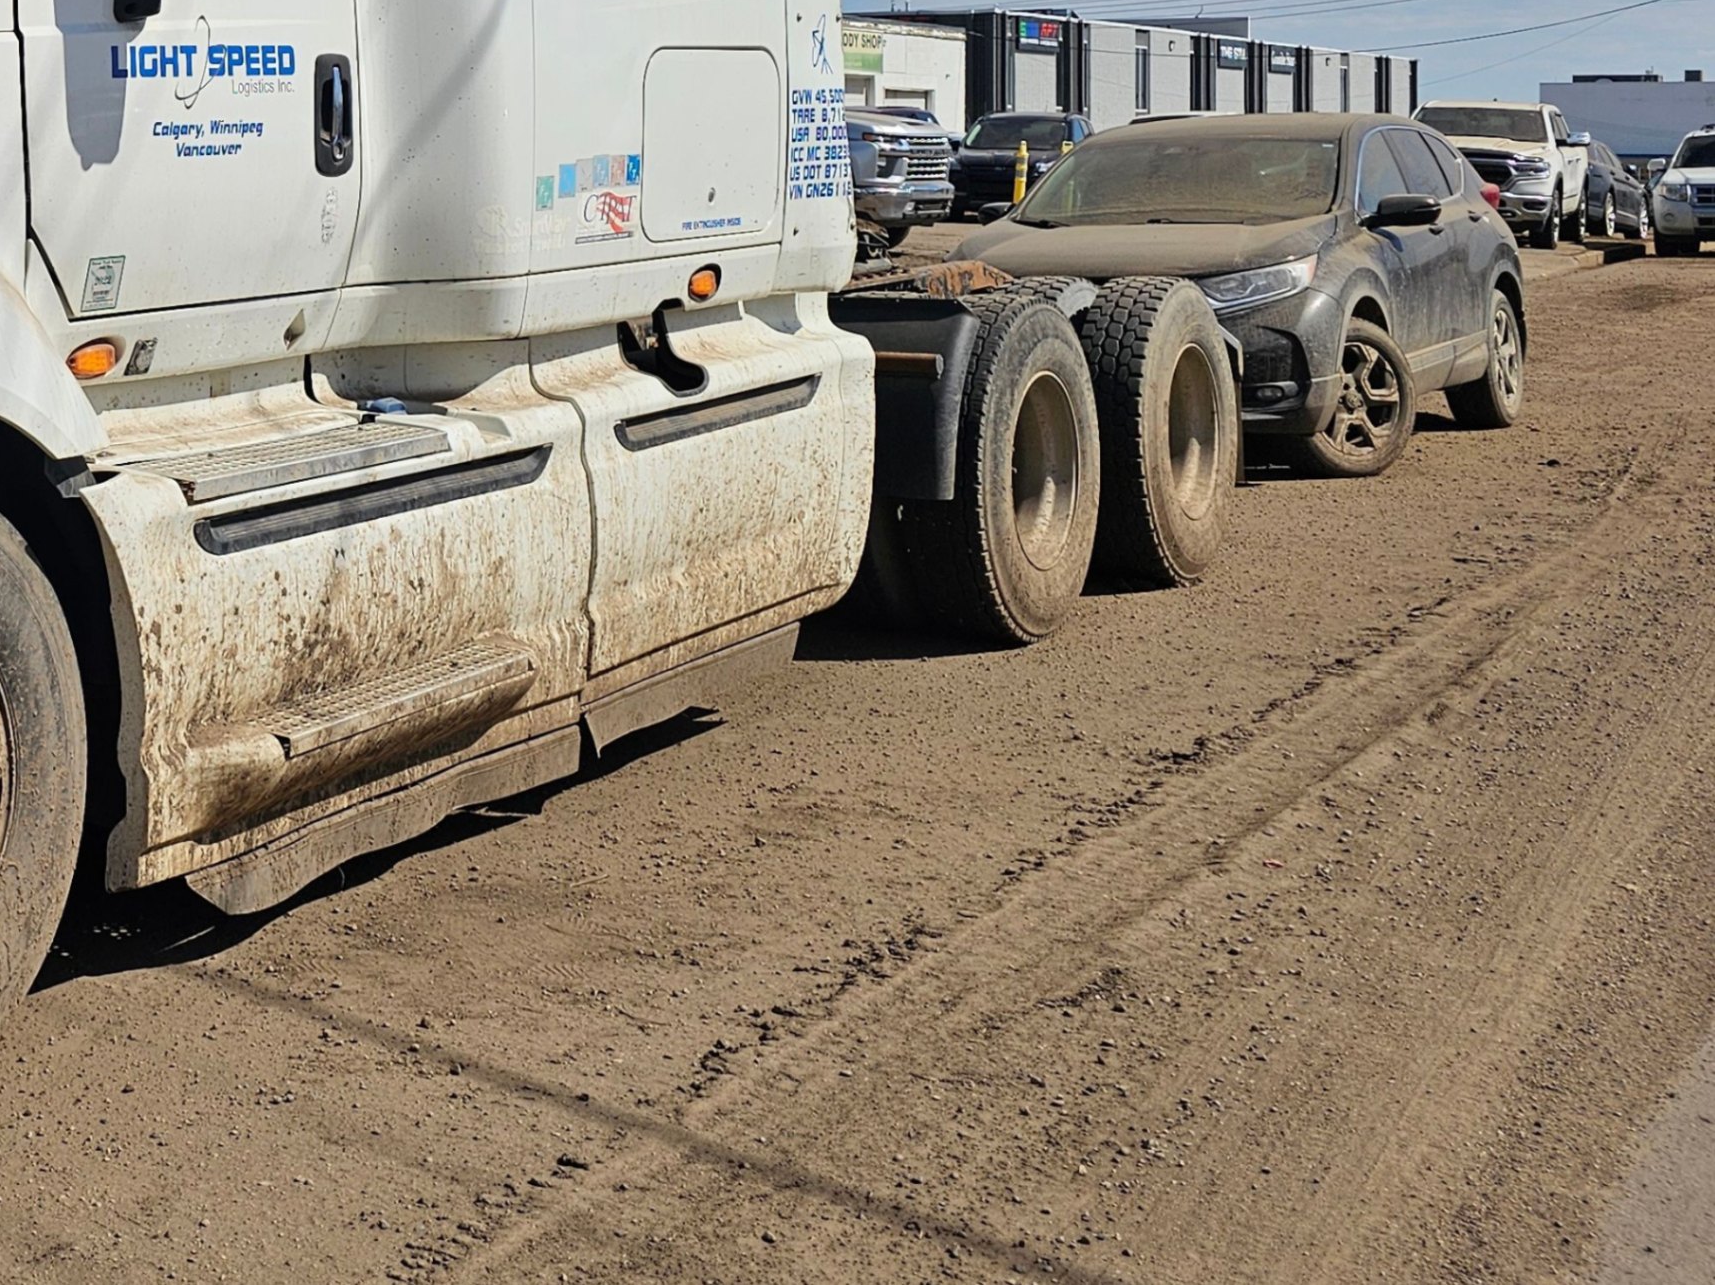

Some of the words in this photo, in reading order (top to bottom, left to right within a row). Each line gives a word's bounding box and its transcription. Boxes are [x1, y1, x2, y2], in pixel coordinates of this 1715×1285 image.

[111, 45, 197, 79] LIGHT
[208, 44, 296, 77] SPEED
[231, 79, 275, 97] Logistics
[277, 80, 295, 93] Inc.
[792, 90, 812, 105] GVW
[792, 108, 815, 123] TARE
[153, 121, 205, 140] Calgary,
[210, 120, 264, 138] Winnipeg
[792, 127, 809, 142] USA
[176, 143, 242, 157] Vancouver
[791, 147, 804, 162] ICC
[807, 146, 821, 161] MC
[790, 166, 801, 182] US
[803, 164, 822, 181] DOT
[789, 184, 803, 200] VIN
